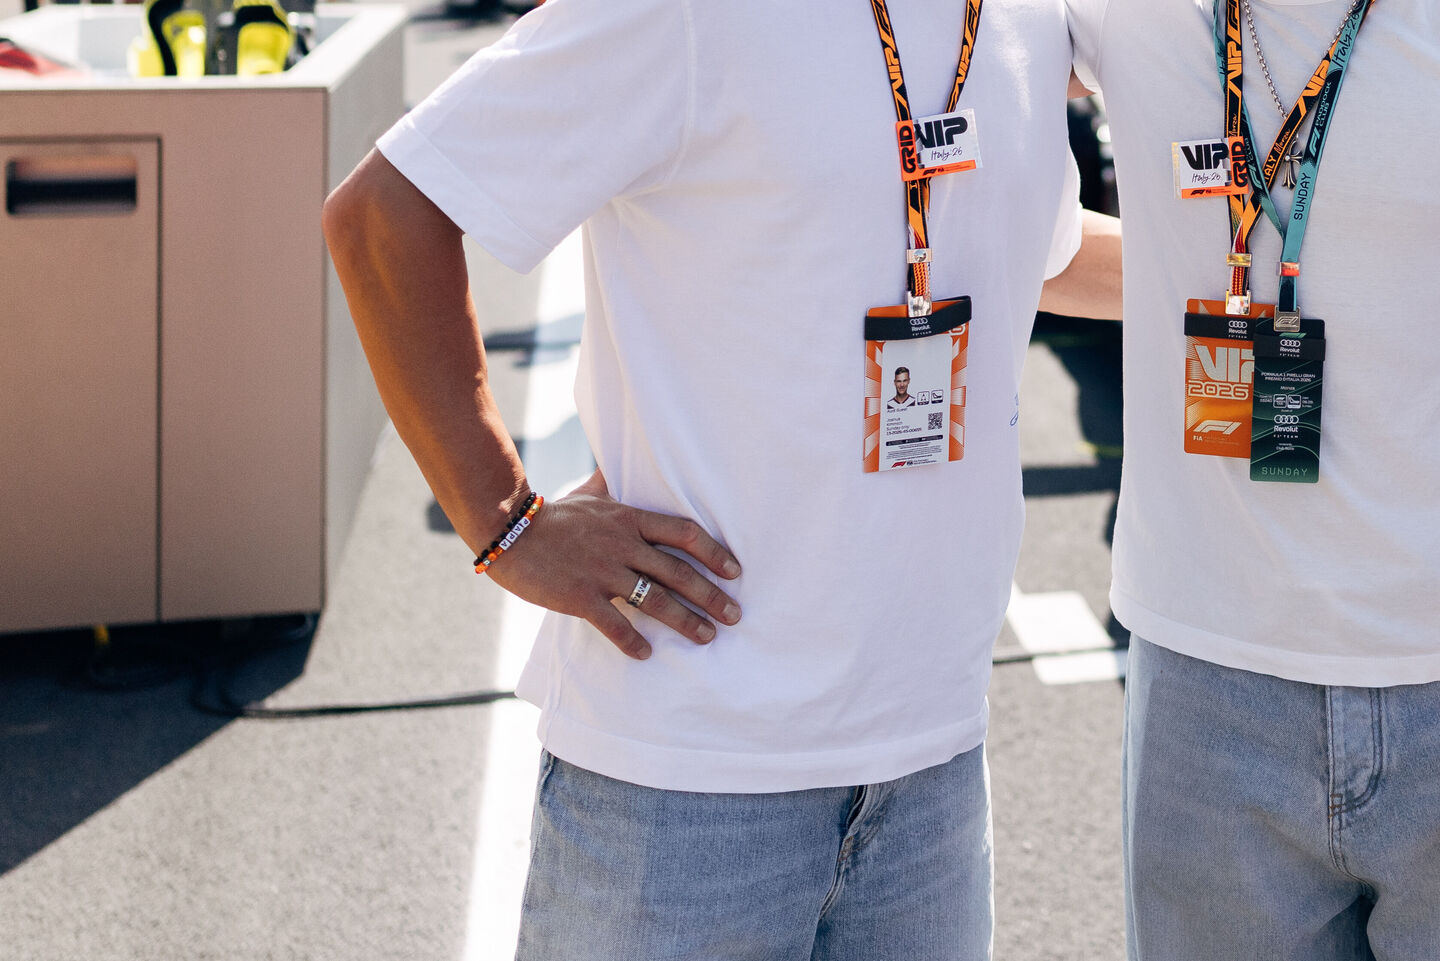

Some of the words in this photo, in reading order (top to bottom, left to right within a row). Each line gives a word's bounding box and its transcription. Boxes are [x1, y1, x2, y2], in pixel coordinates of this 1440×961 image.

[1331, 31, 1353, 68] Italy
[1315, 82, 1332, 126] PADDOCK
[914, 116, 969, 149] VIP
[899, 125, 916, 173] GRID
[931, 149, 950, 161] Italy
[1180, 142, 1230, 171] VIP
[1191, 173, 1209, 184] Italy
[1231, 141, 1248, 188] GRID
[1294, 172, 1311, 221] SUNDAY
[911, 324, 931, 333] Revolut
[1228, 327, 1248, 335] Revolut
[1188, 380, 1250, 401] 2026
[1193, 420, 1243, 435] F1
[1261, 466, 1308, 476] SUNDAY
[499, 517, 530, 549] PAPA
